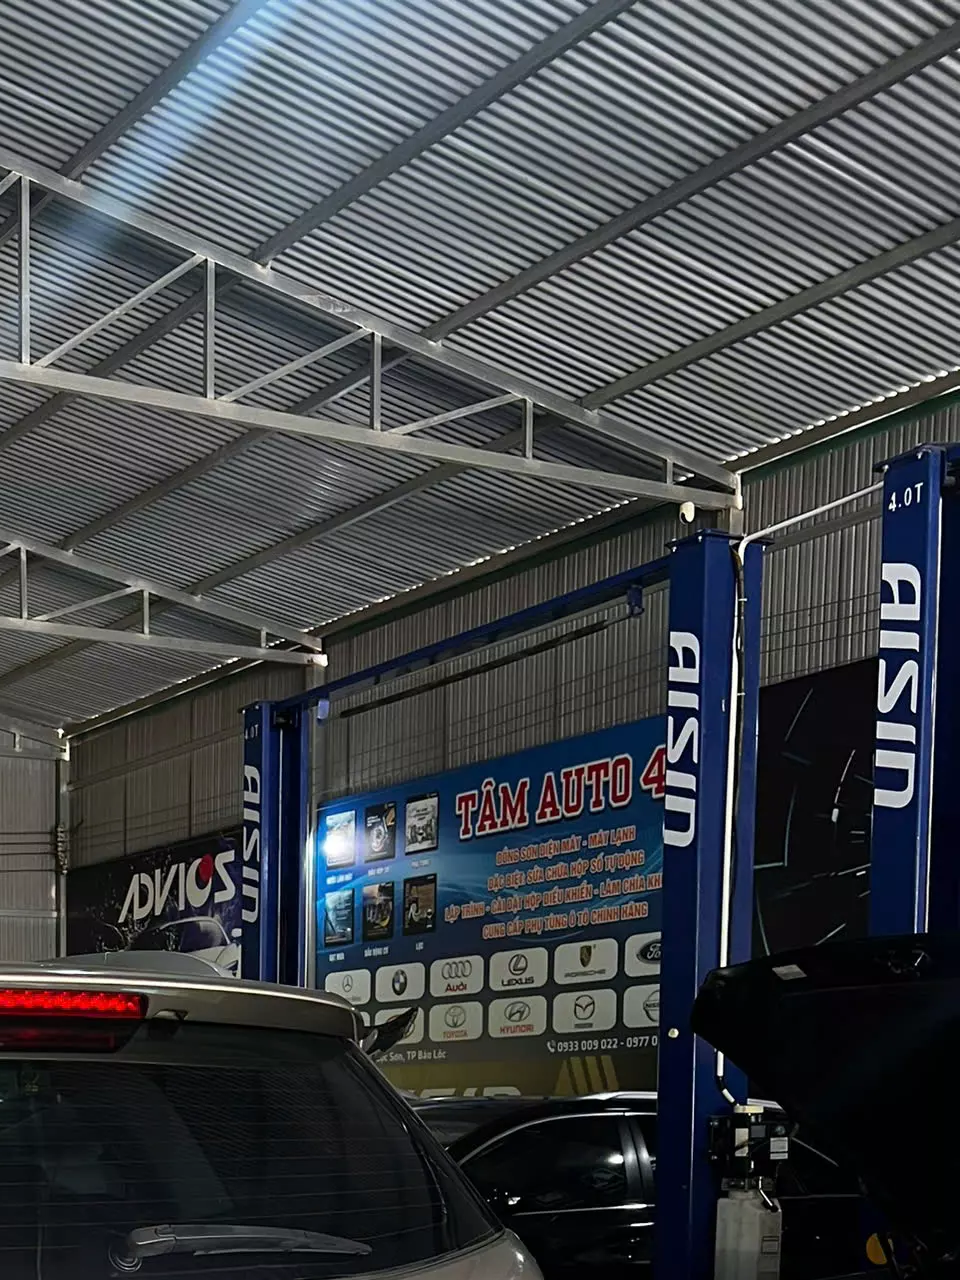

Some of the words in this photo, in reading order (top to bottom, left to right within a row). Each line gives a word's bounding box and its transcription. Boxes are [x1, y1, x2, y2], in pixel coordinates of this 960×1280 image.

[888, 482, 924, 512] 4.0T
[455, 777, 530, 839] TÂM
[536, 753, 633, 824] AUTO
[610, 825, 636, 846] LẠNH
[589, 852, 604, 873] SỐ
[482, 922, 506, 940] CUNG
[445, 982, 468, 992] Audi
[501, 976, 535, 987] LEXUS
[500, 1024, 534, 1034] HYUNDAI
[557, 1040, 579, 1052] 0933
[581, 1039, 599, 1051] 009
[600, 1038, 618, 1049] 022
[626, 1035, 650, 1048] 0977
[406, 1050, 417, 1060] TP
